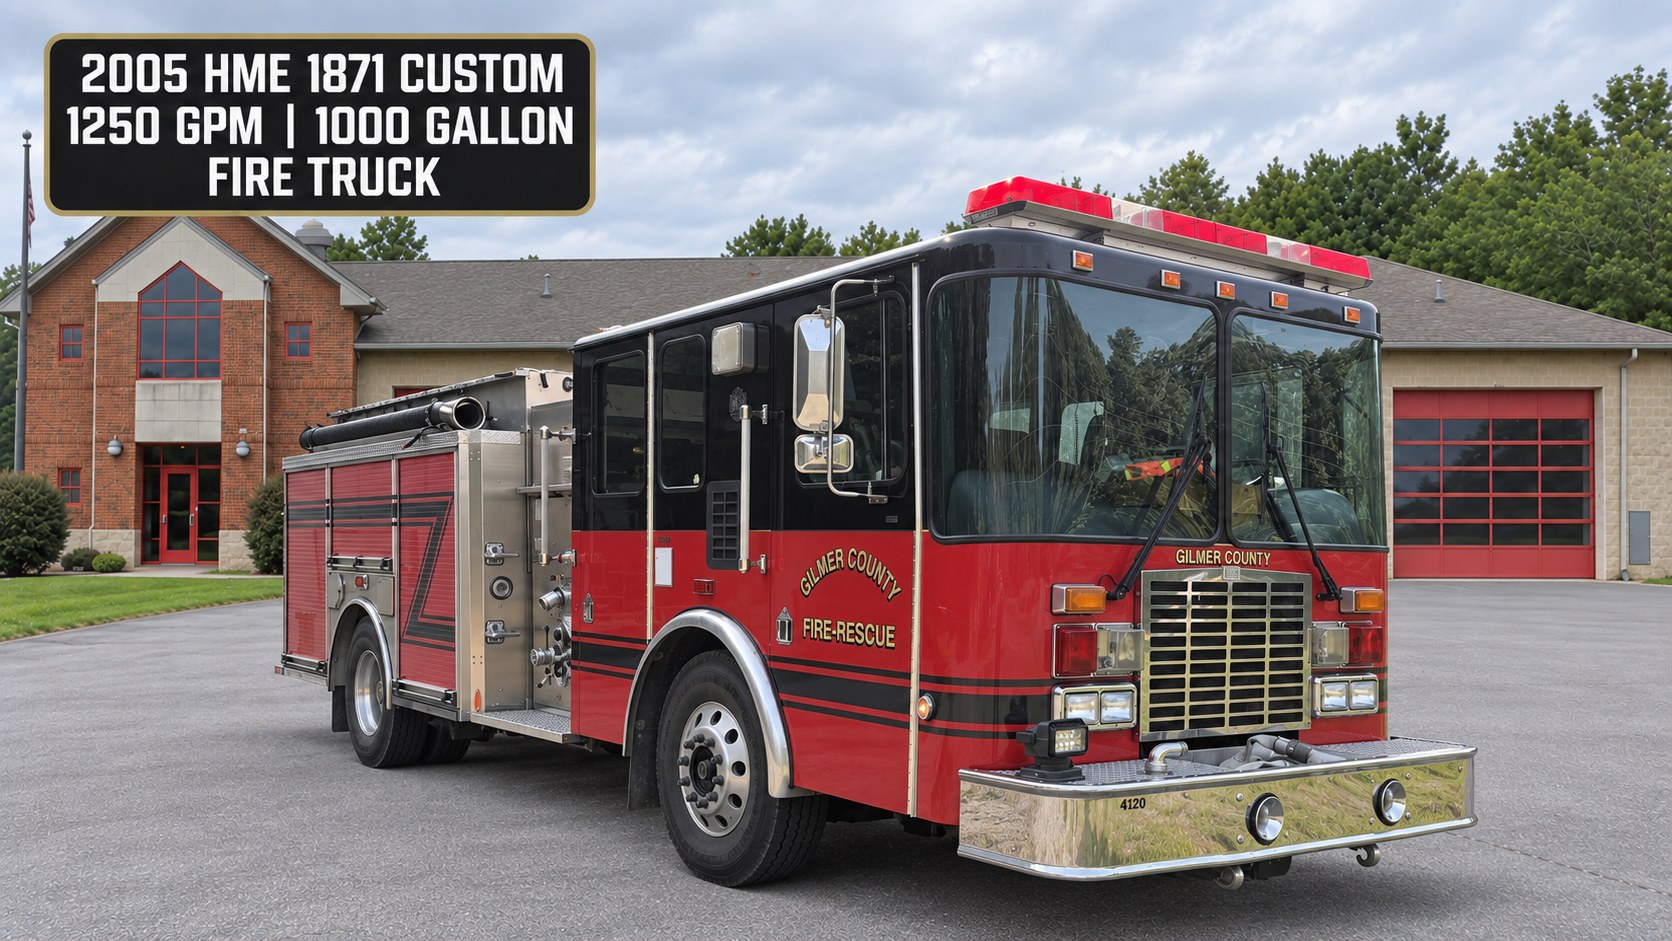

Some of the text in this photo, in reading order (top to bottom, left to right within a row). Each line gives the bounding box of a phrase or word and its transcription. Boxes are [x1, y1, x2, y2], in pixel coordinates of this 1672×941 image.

[1175, 549, 1271, 566] GILMER COUNTY
[800, 547, 902, 601] GILMER COUNTY
[803, 617, 896, 650] FIRE-RESCUE
[1120, 797, 1146, 811] 4120
